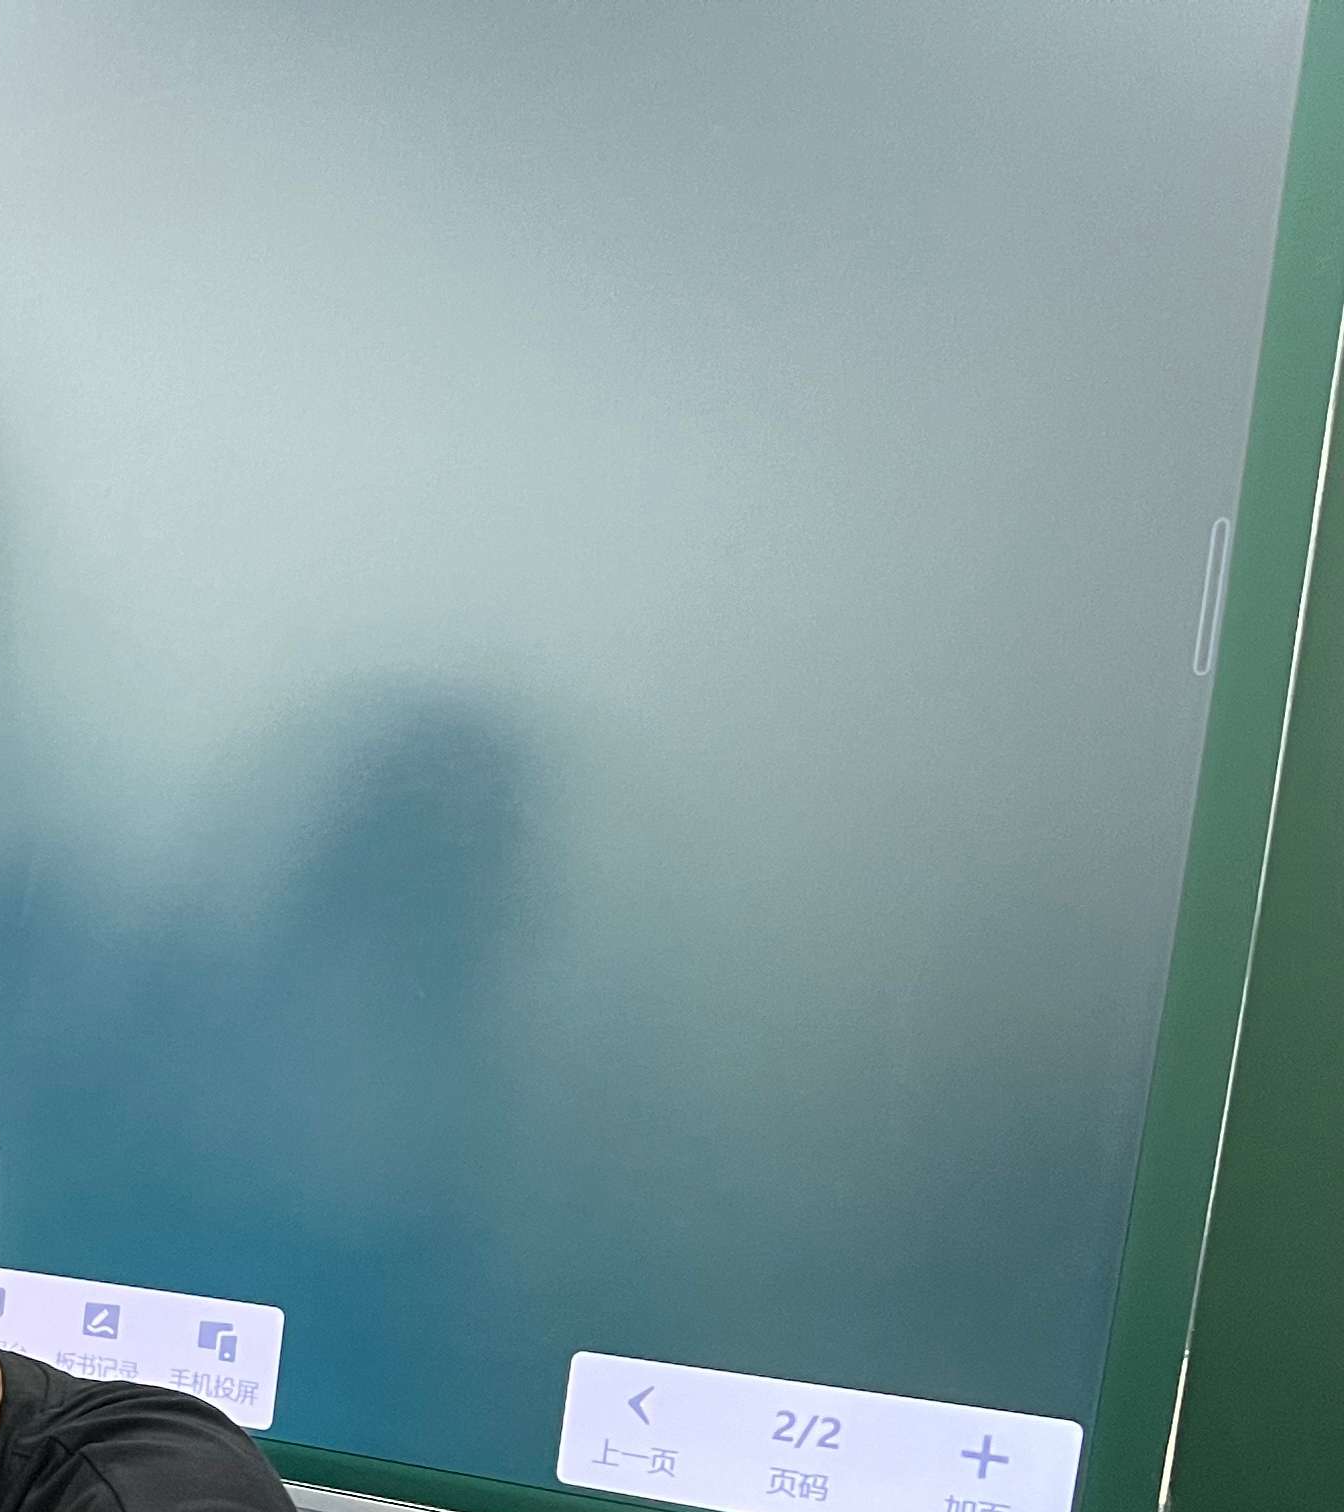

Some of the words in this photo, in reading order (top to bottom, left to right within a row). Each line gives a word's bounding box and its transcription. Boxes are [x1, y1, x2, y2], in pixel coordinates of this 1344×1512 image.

[169, 1366, 261, 1407] 手机投屏
[771, 1409, 843, 1451] 2/2
[592, 1437, 680, 1478] 上一页
[765, 1466, 830, 1503] 页码
